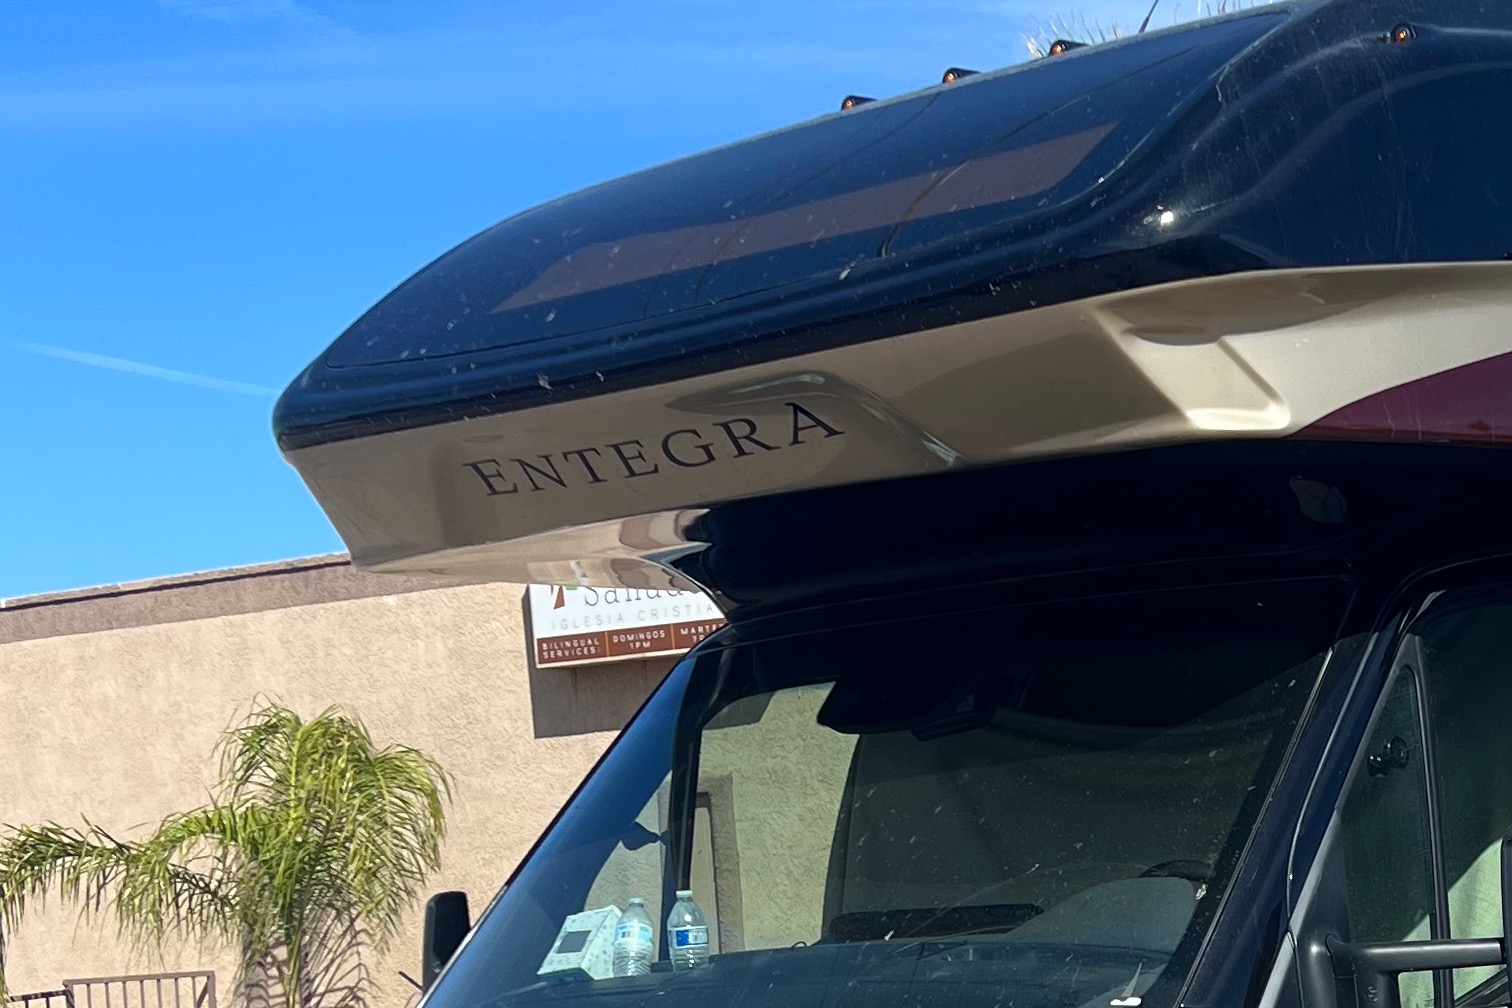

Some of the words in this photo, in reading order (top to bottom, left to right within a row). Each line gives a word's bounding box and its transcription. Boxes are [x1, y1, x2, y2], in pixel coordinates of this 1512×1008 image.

[462, 402, 846, 496] ENTEGRA
[551, 613, 625, 630] IGLESIA
[612, 629, 666, 644] DOMINGOS
[541, 638, 600, 651] BILINGUAL
[629, 641, 651, 650] 1PM
[542, 646, 597, 659] SERVICES
